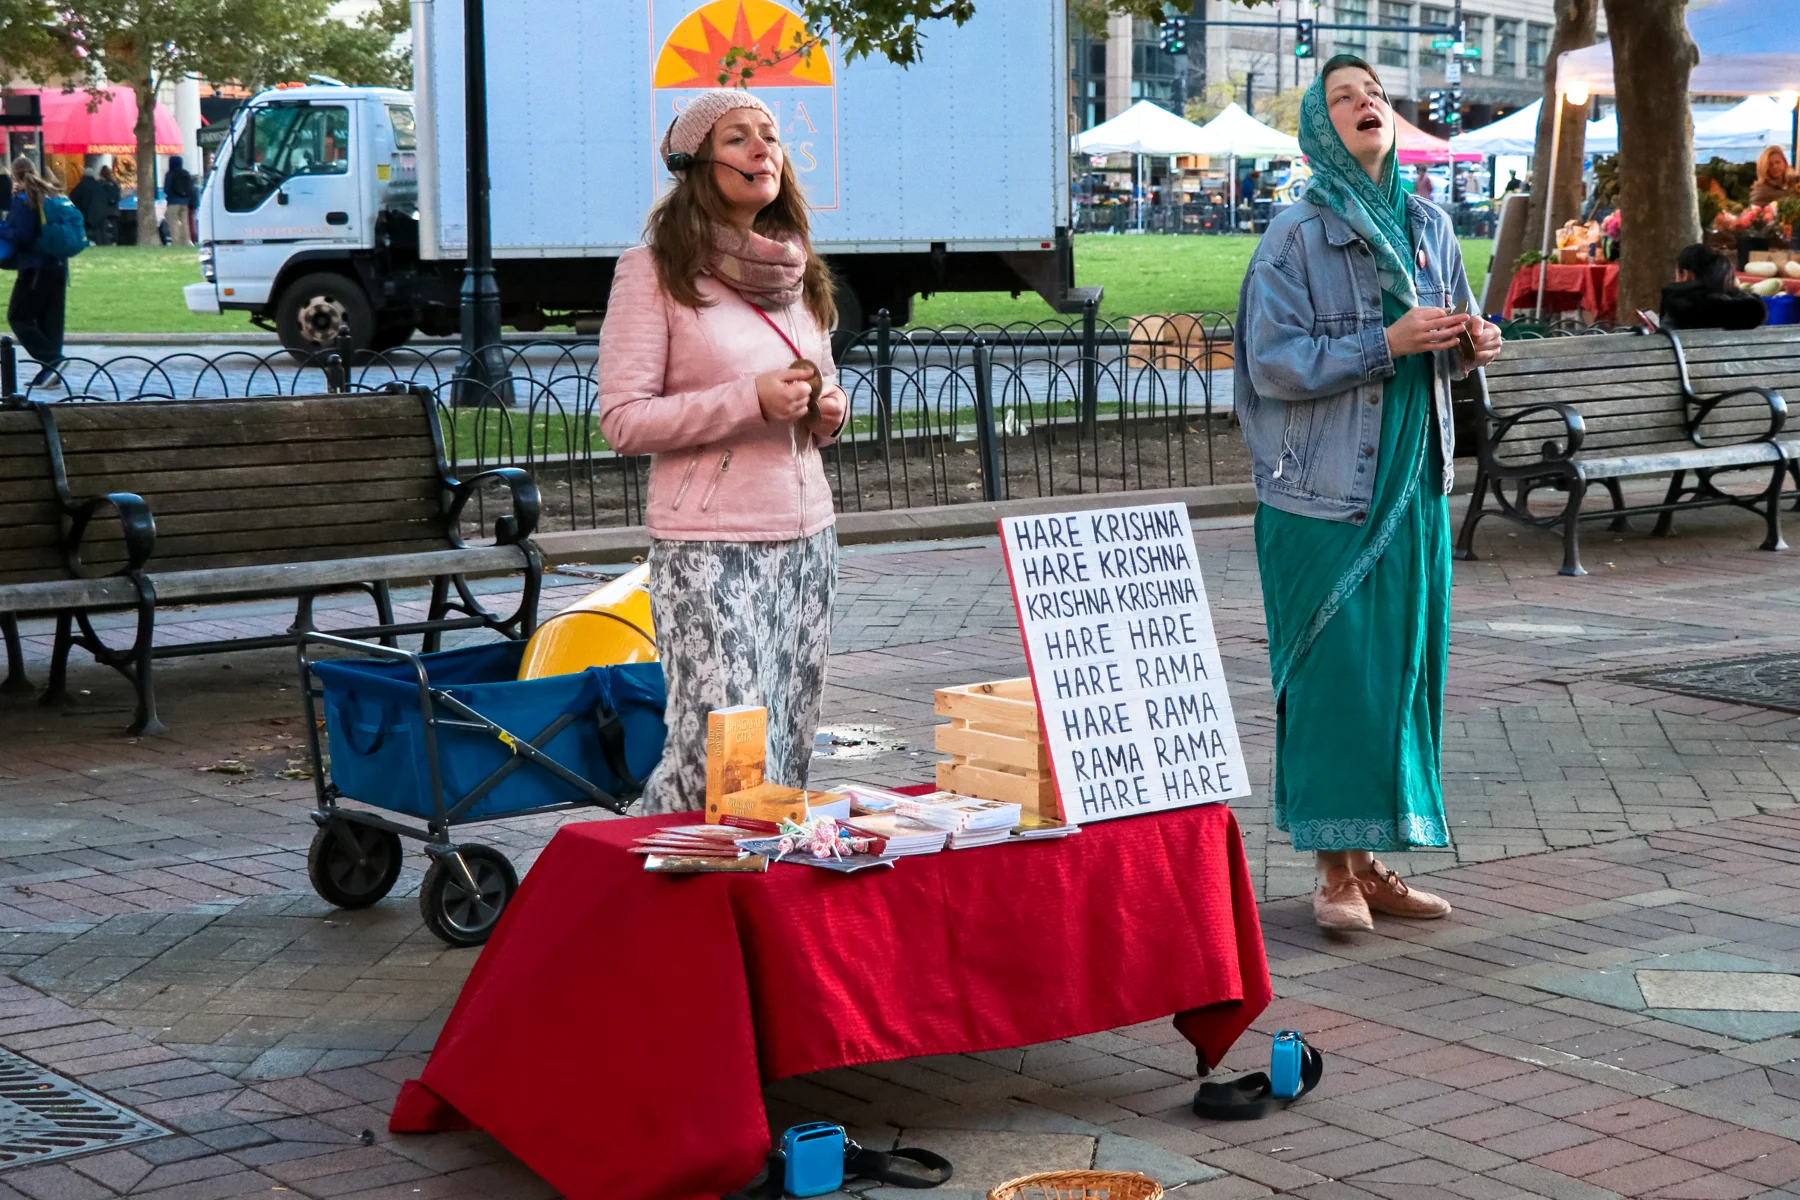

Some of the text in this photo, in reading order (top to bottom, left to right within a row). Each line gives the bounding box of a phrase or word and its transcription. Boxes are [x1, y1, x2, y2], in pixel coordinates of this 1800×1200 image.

[87, 144, 137, 154] FAIRMONT
[1014, 509, 1184, 552] HARE KRISHNA
[1022, 543, 1191, 588] HARE KRISHNA
[1025, 577, 1199, 622] KRISHNA KRISHNA
[1044, 613, 1197, 661] HARE HARE
[1053, 652, 1209, 699] HARE RAMA
[727, 716, 764, 734] BHAGAVAD
[735, 731, 752, 743] GITA
[1062, 691, 1219, 742] HARE RAMA
[1071, 728, 1227, 784] RAMA RAMA
[1079, 762, 1234, 817] HARE HARE
